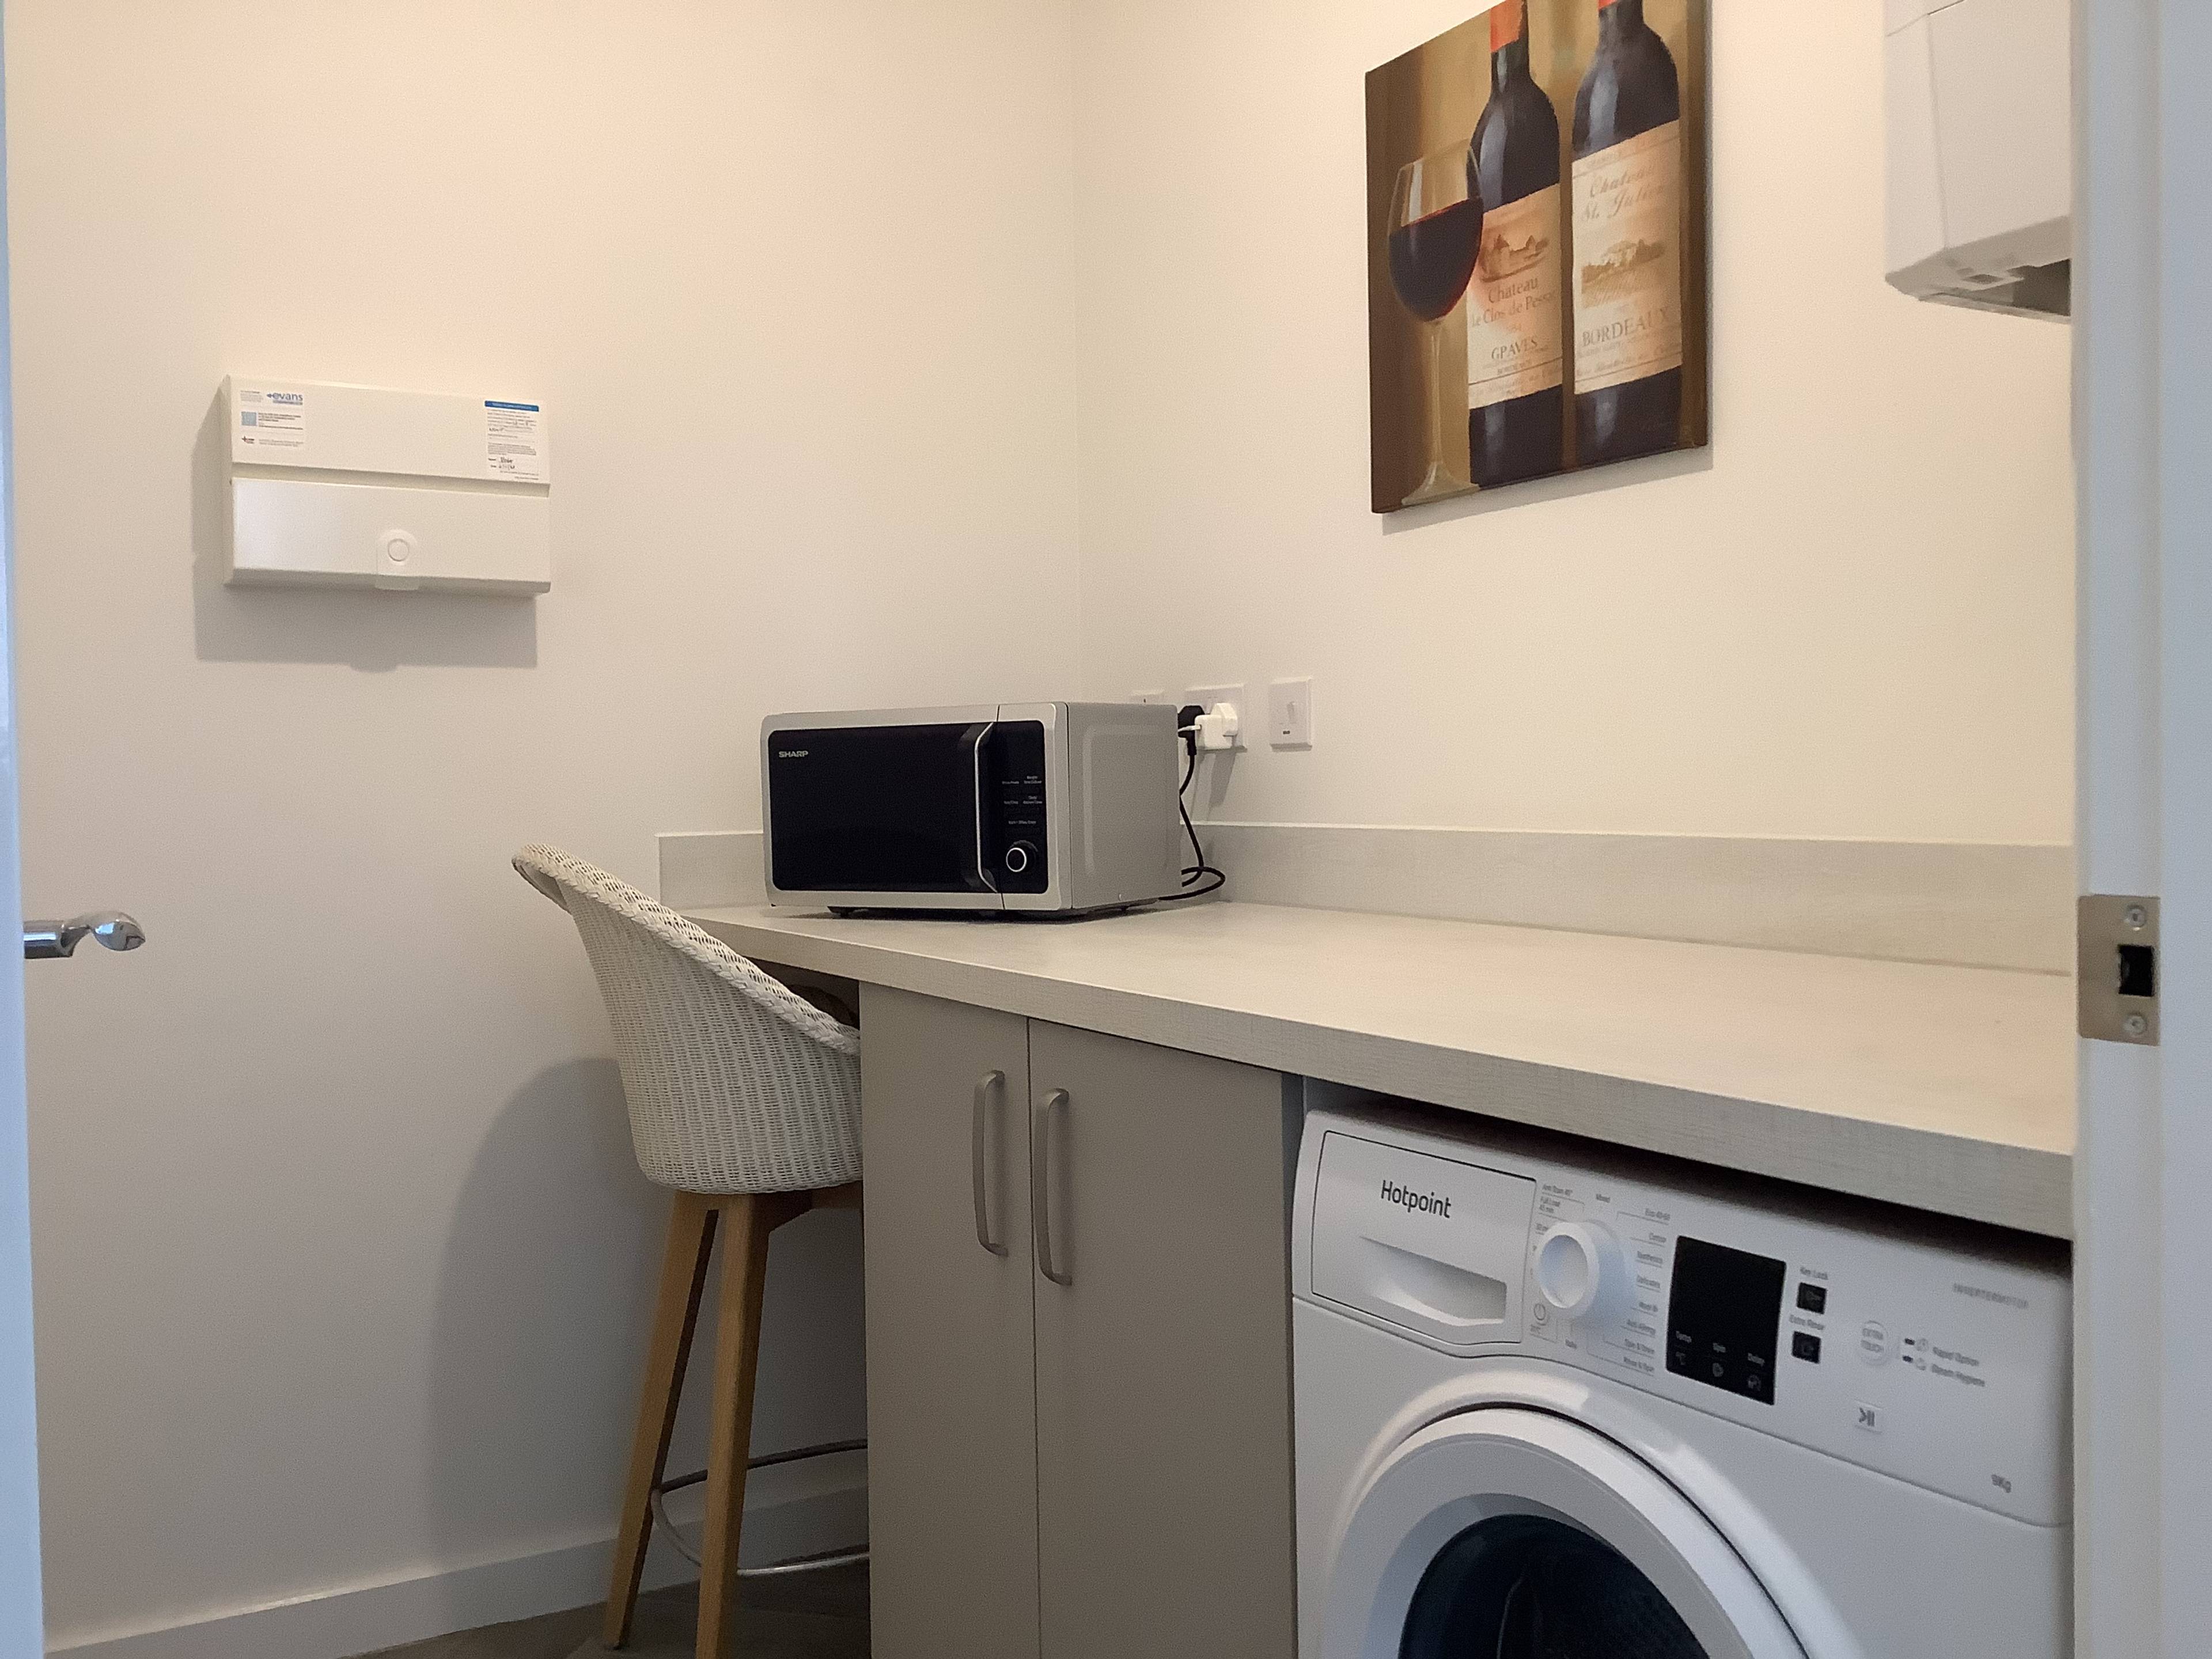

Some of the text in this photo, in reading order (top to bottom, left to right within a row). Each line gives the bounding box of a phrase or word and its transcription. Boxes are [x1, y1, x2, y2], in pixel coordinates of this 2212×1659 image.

[1488, 278, 1538, 303] Chateau
[1582, 307, 1668, 346] BORDEAUX
[273, 393, 303, 402] evans
[1381, 1180, 1452, 1218] Hotpoint
